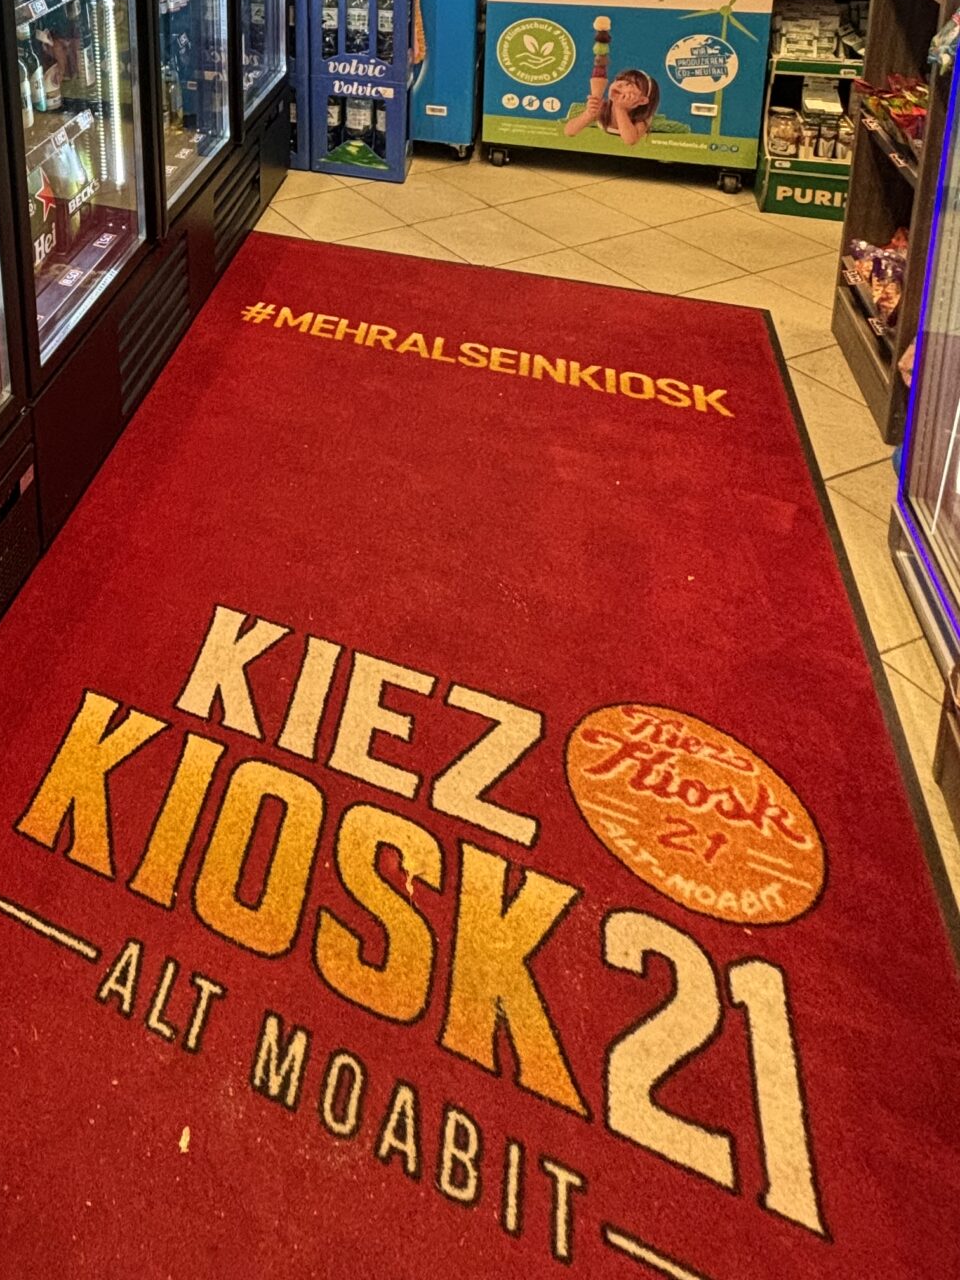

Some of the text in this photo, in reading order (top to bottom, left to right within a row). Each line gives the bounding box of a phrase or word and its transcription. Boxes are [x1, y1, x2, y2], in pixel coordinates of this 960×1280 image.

[328, 58, 386, 78] volvic
[776, 185, 847, 207] PURI
[240, 301, 735, 418] #MEHRALSEINKIOSK
[176, 604, 545, 848] KIEZ
[580, 727, 814, 850] Kiosk
[657, 814, 728, 868] 21
[14, 689, 590, 1119] KIOSK
[97, 940, 585, 1263] ALT MOABIT
[603, 911, 833, 1241] 21
